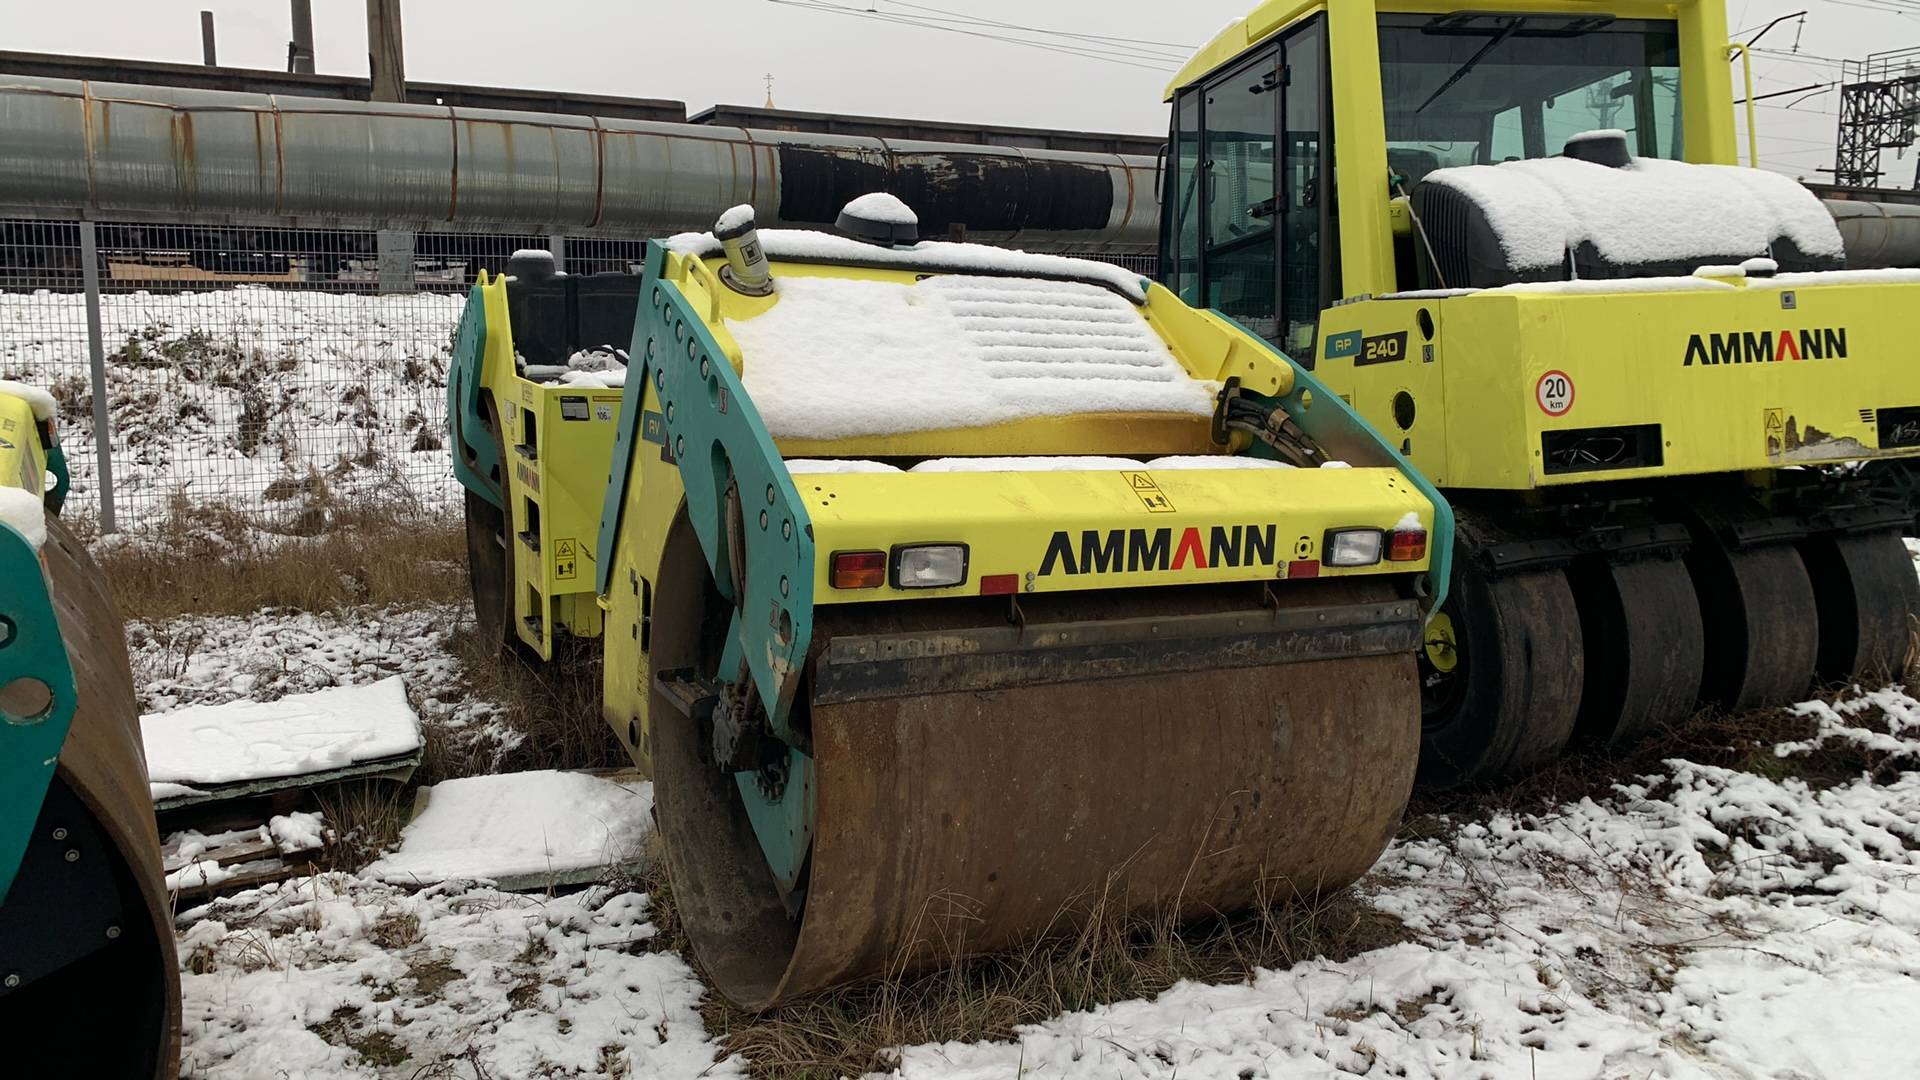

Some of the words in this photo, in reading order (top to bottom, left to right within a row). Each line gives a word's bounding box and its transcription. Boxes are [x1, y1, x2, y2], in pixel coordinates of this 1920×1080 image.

[1335, 338, 1352, 352] AP
[1366, 338, 1399, 360] 240
[1683, 328, 1848, 366] AMMANN
[1545, 378, 1566, 398] 20
[1550, 401, 1564, 409] km
[1038, 524, 1276, 576] AMMANN
